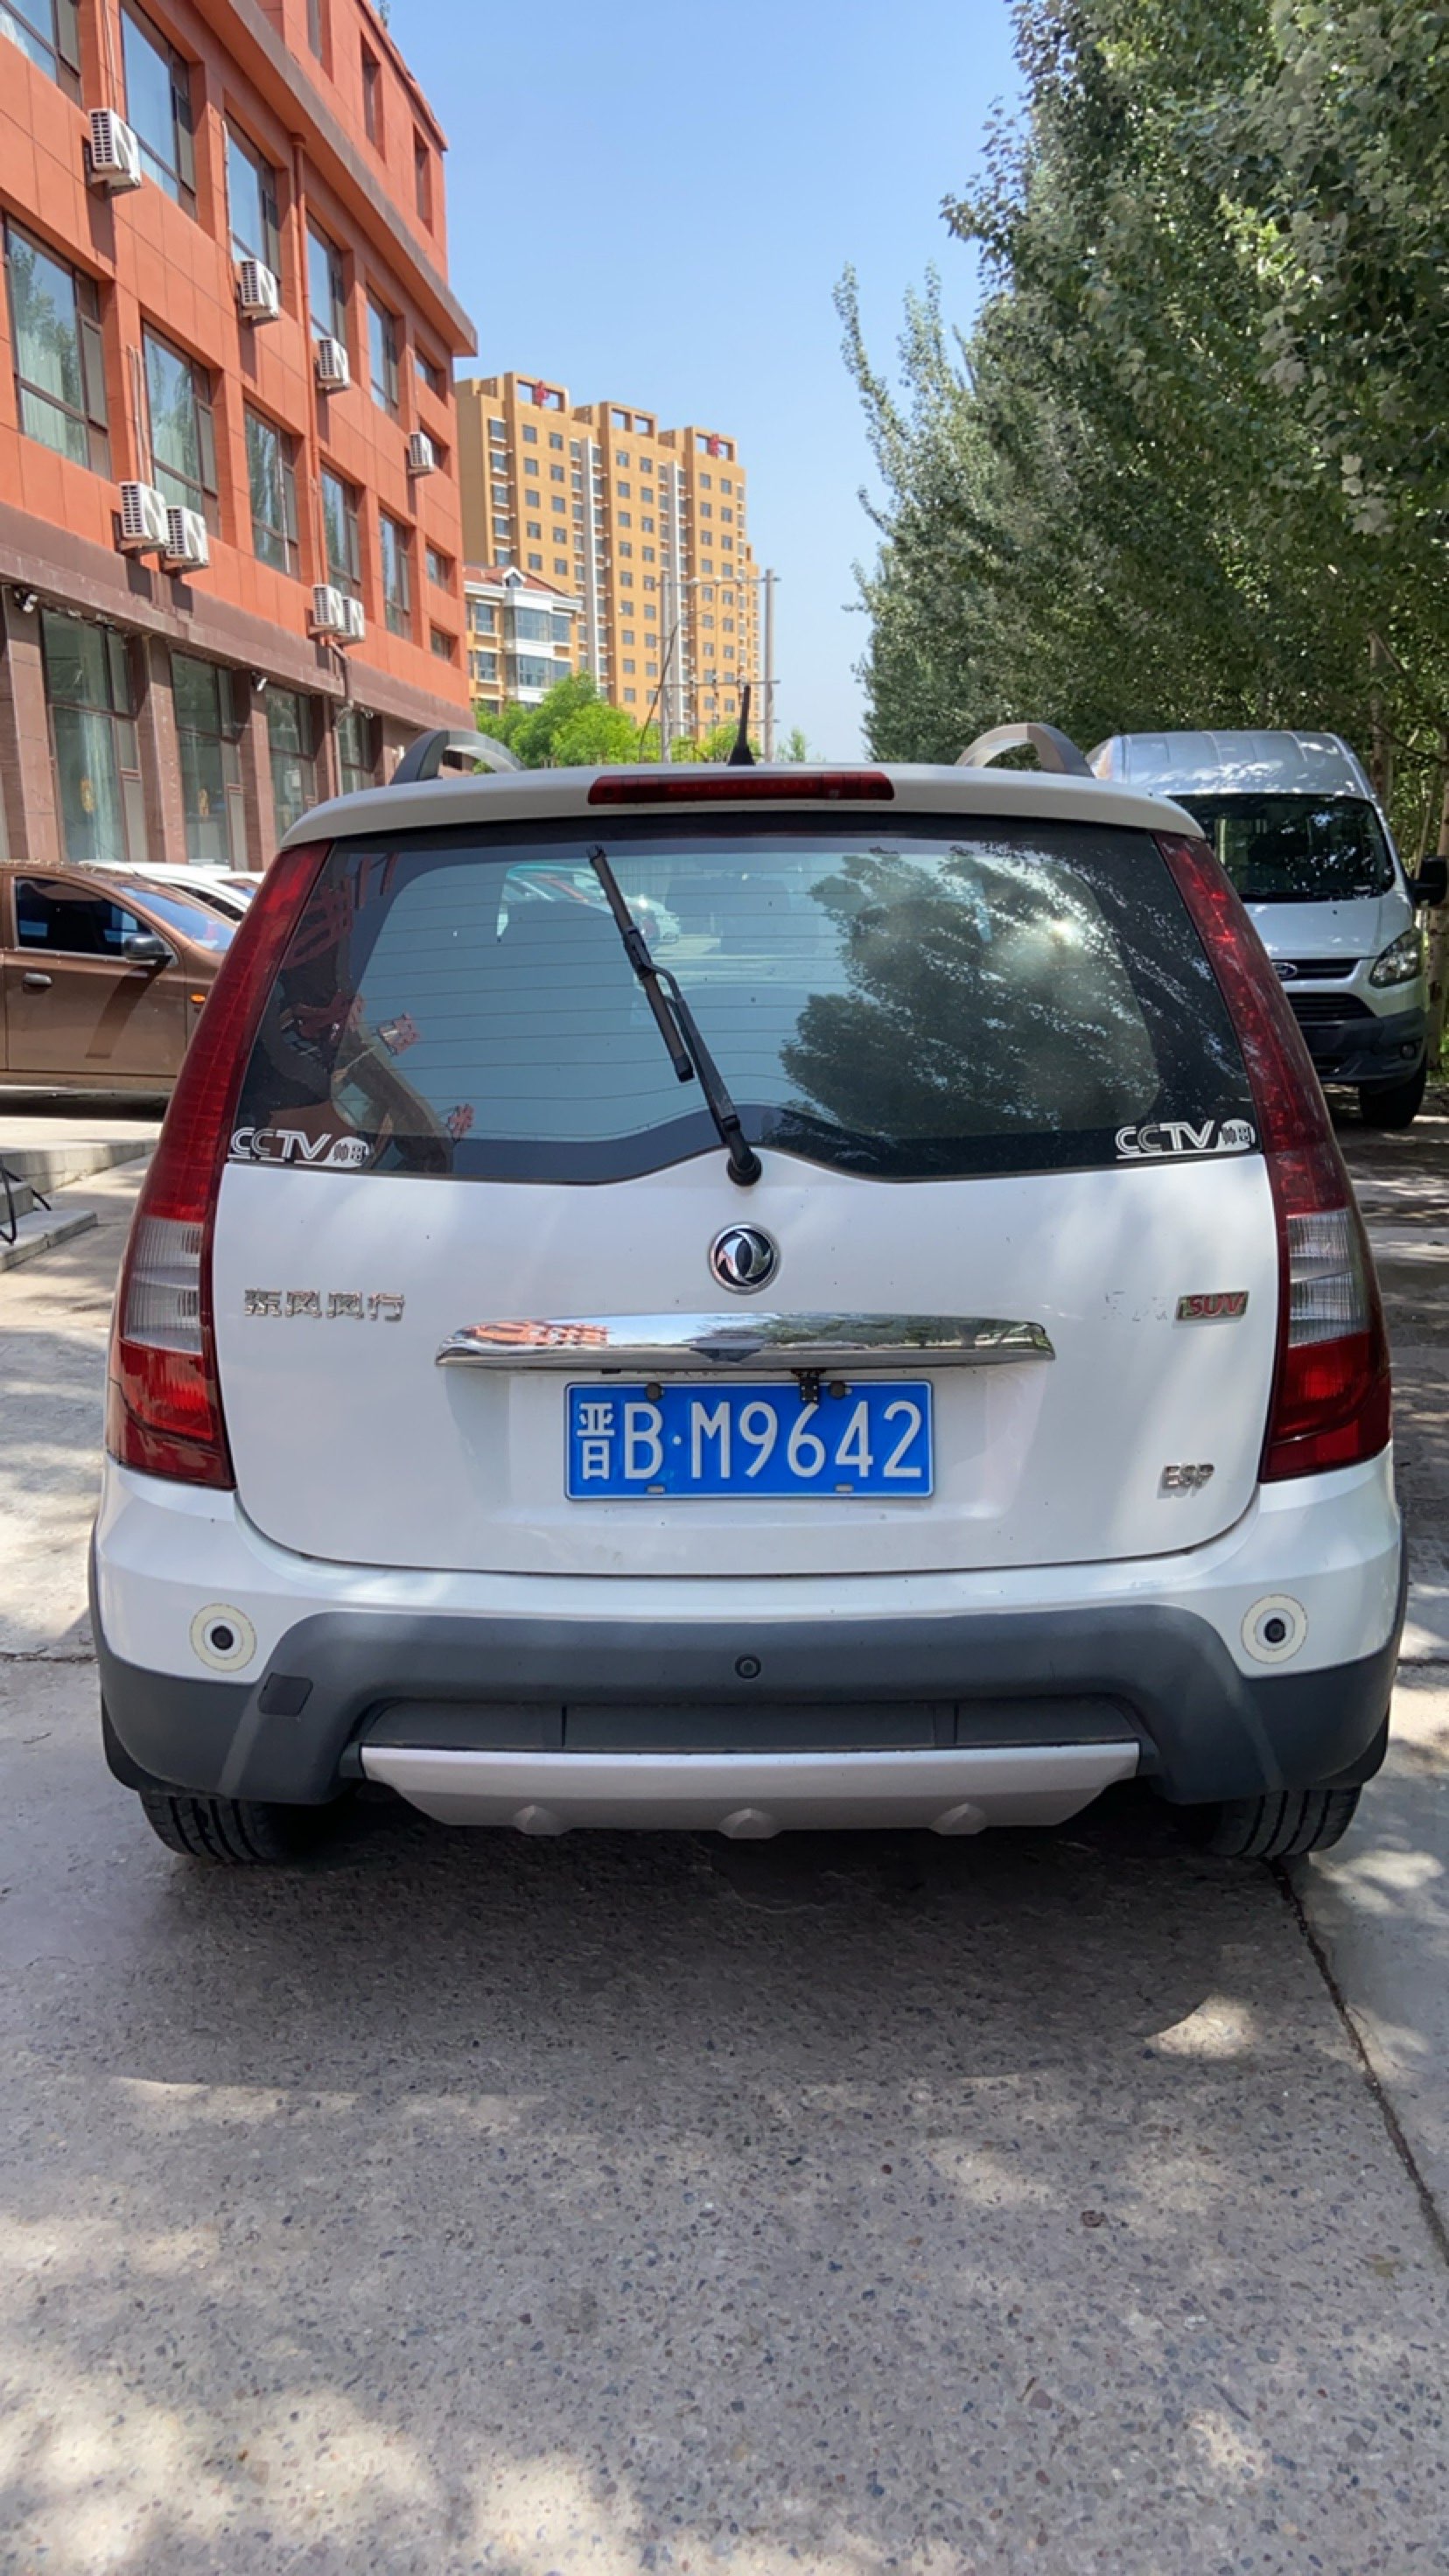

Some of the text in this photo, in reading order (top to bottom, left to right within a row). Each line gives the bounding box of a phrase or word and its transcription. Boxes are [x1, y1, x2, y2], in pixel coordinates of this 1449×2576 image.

[230, 1127, 332, 1159] CCTV
[1115, 1119, 1215, 1155] CCTV
[244, 1288, 405, 1321] 东风风行
[1187, 1293, 1246, 1317] SUV
[1161, 1464, 1214, 1489] ESP
